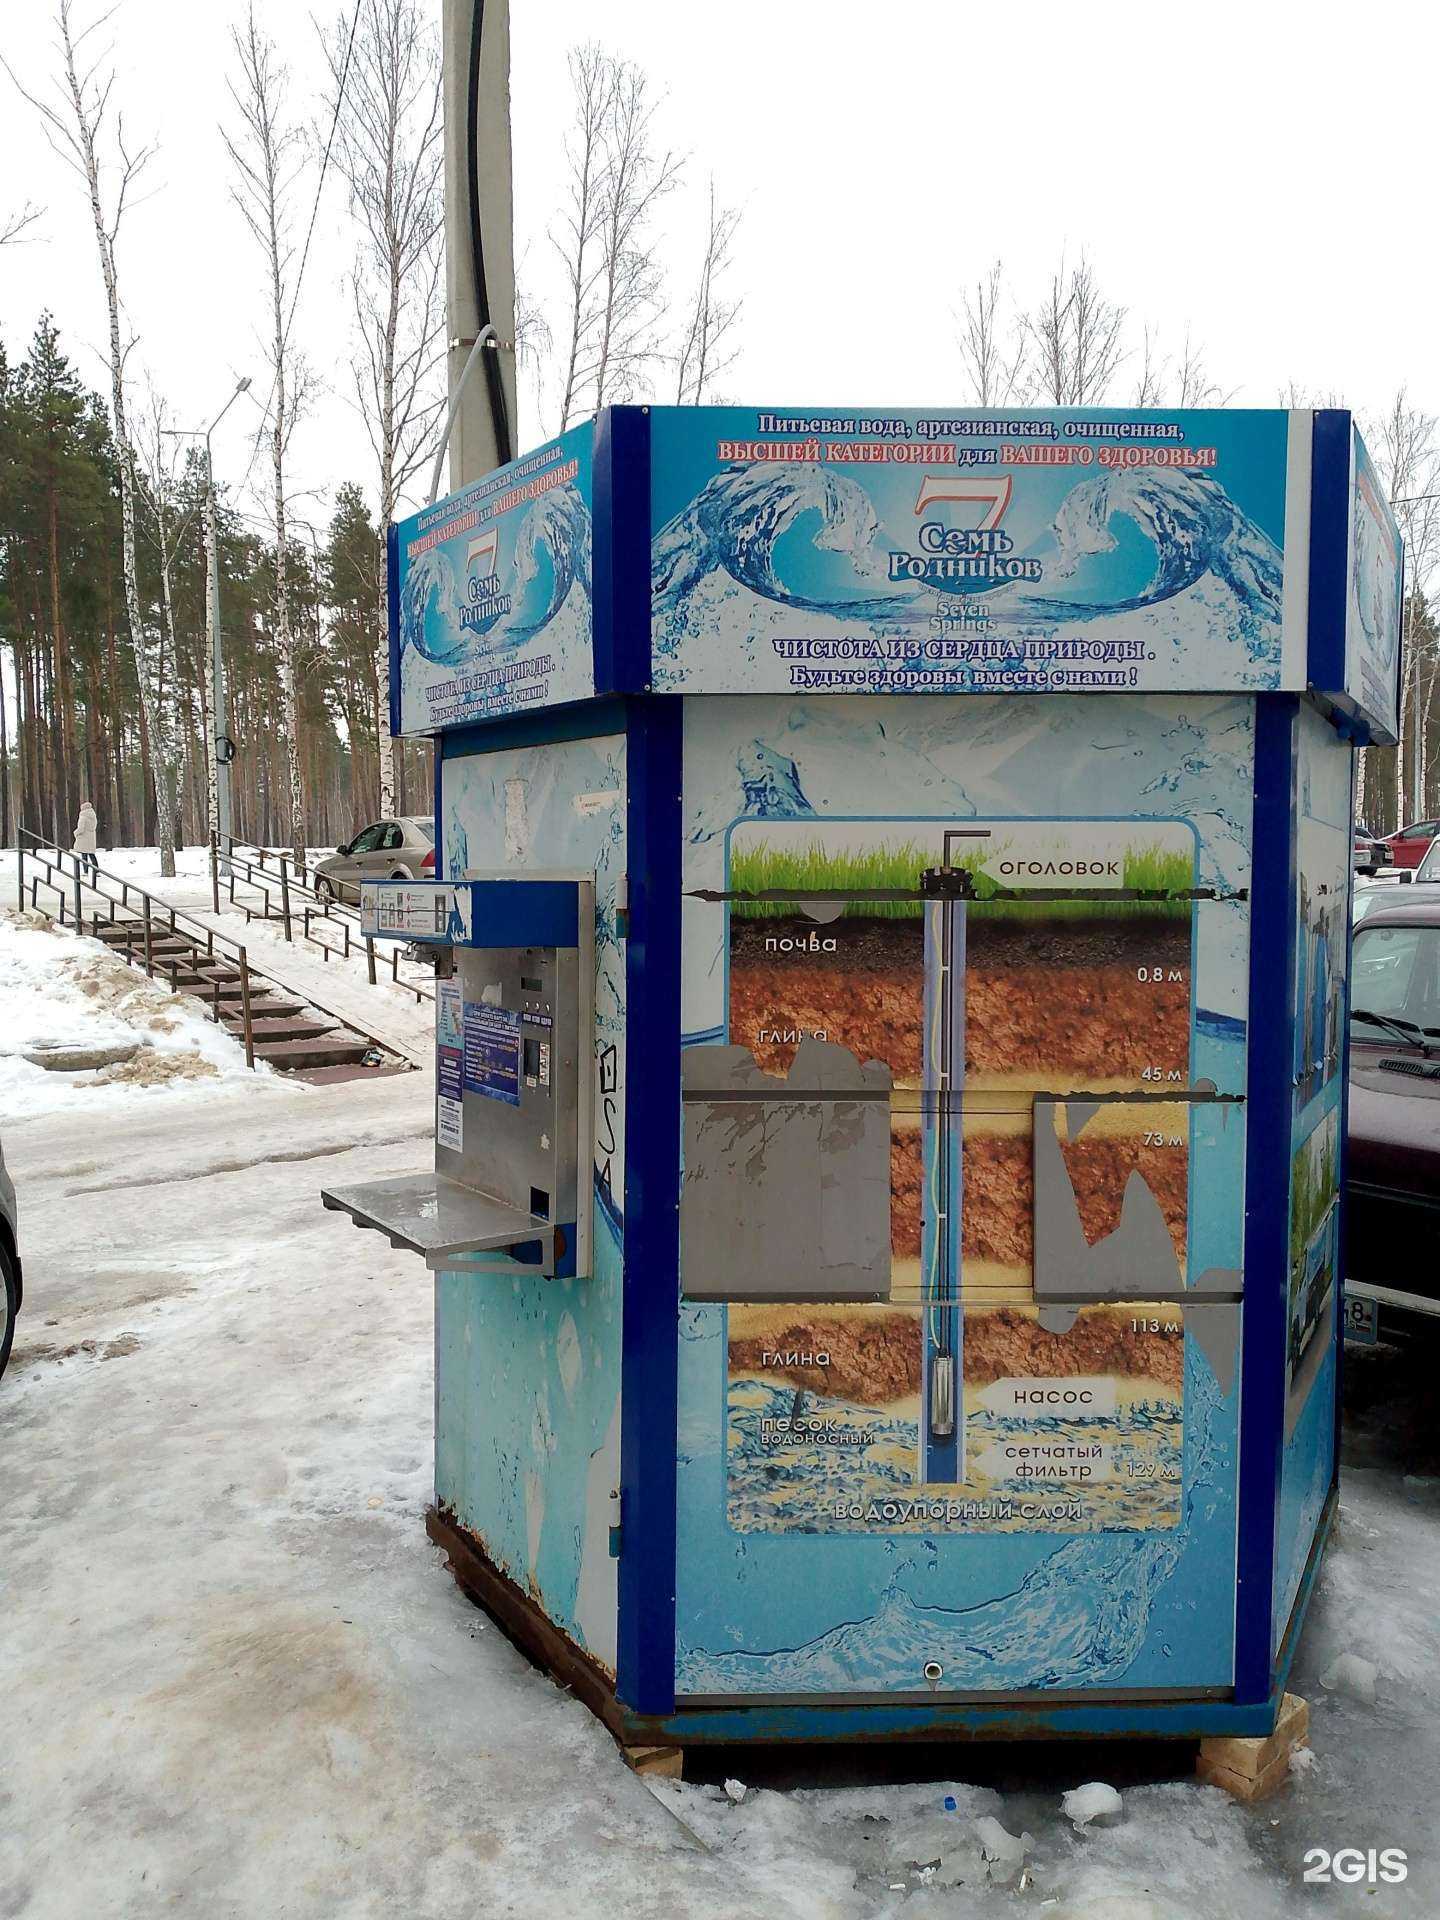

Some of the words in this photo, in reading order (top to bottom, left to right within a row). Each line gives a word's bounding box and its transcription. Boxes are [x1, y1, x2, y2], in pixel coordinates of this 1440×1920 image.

[759, 414, 854, 434] Питьевая
[859, 419, 911, 438] вода,
[917, 420, 1059, 440] артезианская,
[1063, 421, 1184, 440] очищенная,
[717, 439, 821, 462] ВЫСШЕЙ
[825, 442, 956, 463] КАТЕГОРИИ
[959, 449, 998, 467] для
[1000, 445, 1094, 465] ВАШЕГО
[1098, 446, 1216, 468] ЗДОРОВЬЯ!
[492, 486, 527, 518] ВАШЕГО
[527, 459, 579, 499] ЗДОРОВЬЯ!
[914, 473, 1013, 558] 7
[919, 522, 1014, 554] Семь
[467, 527, 498, 577] 7
[889, 552, 1043, 582] Родников
[937, 602, 989, 617] Seven
[930, 617, 997, 634] Springs
[773, 640, 885, 659] ЧИСТОТА
[887, 640, 921, 658] ИЗ
[924, 640, 1020, 661] СЕРДЦА
[790, 667, 865, 687] Будьте
[868, 670, 963, 689] здоровы
[972, 671, 1048, 684] вместе
[1051, 672, 1065, 684] с
[1000, 861, 1119, 875] оголовок
[765, 938, 838, 952] почва
[1137, 967, 1163, 983] 0,8
[1167, 973, 1183, 982] м
[1141, 1066, 1162, 1082] 45
[1167, 1073, 1182, 1082] м
[1143, 1132, 1164, 1147] 73
[1168, 1138, 1183, 1147] м
[1130, 1319, 1160, 1333] 113
[1163, 1323, 1179, 1333] м
[761, 1352, 831, 1366] глина
[1013, 1390, 1093, 1404] насос
[760, 1418, 838, 1432] песок
[760, 1432, 874, 1445] водоносный
[1005, 1446, 1102, 1458] сетчатый
[1015, 1462, 1092, 1480] фильтр
[1126, 1462, 1156, 1478] 129
[1159, 1469, 1176, 1478] м
[834, 1498, 1013, 1524] водоупорный
[1019, 1498, 1083, 1520] слой
